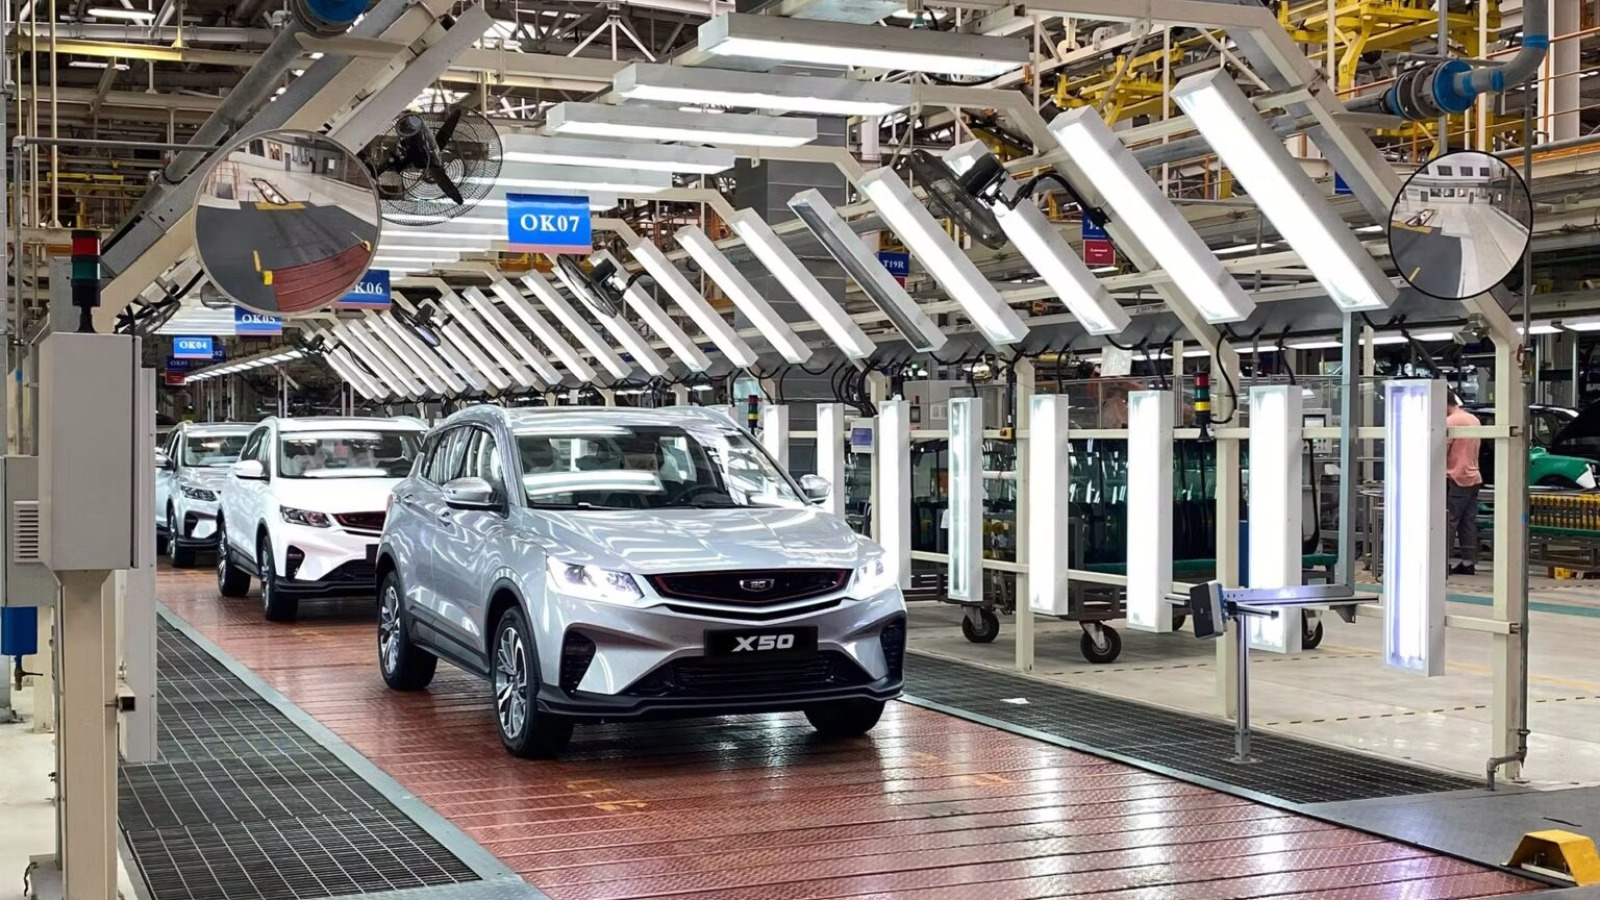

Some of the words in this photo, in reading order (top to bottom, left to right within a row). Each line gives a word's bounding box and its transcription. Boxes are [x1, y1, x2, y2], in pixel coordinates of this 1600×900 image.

[520, 213, 580, 232] OK07
[883, 259, 904, 269] T19R
[354, 281, 383, 295] K06
[179, 340, 208, 350] OK04
[731, 634, 795, 653] X50
